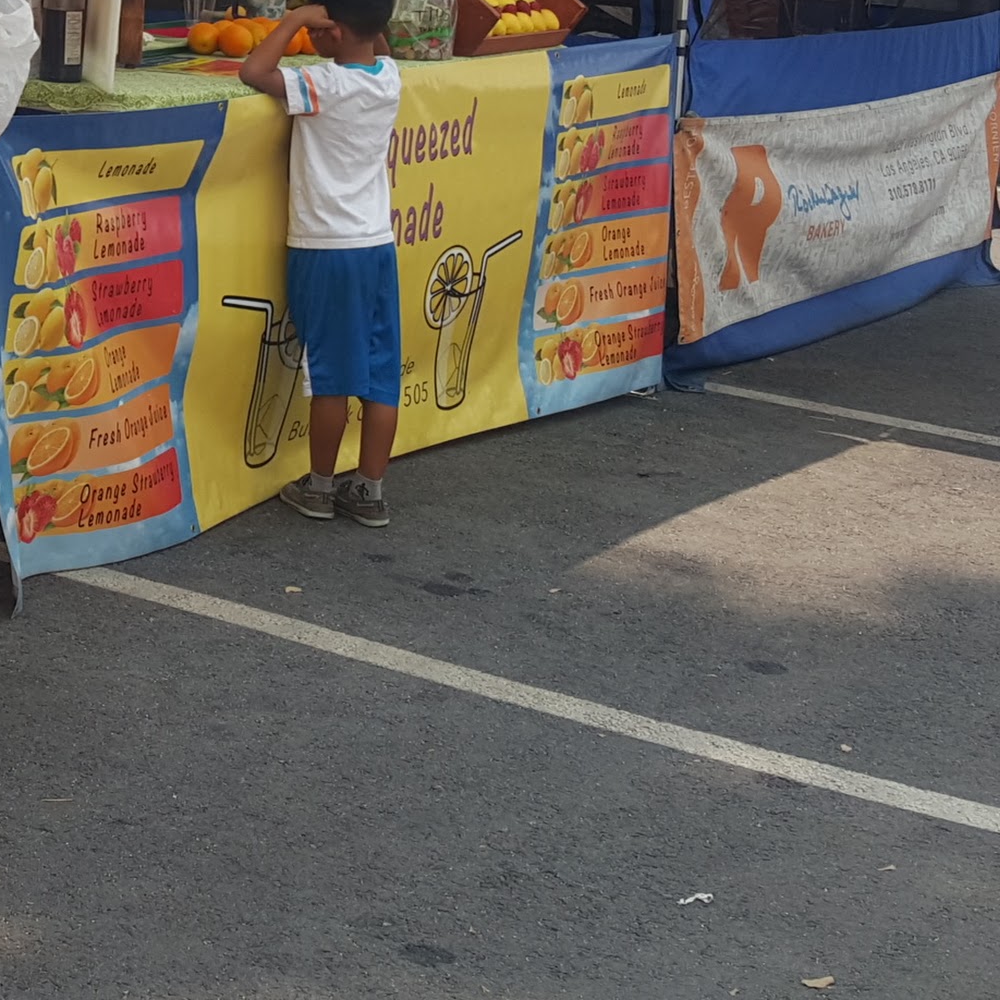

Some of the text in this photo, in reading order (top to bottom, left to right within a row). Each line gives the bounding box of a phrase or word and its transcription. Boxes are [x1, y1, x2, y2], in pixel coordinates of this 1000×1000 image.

[616, 80, 647, 99] Lemonade
[386, 96, 477, 189] queezed
[948, 123, 972, 139] Blvd.
[97, 157, 157, 179] Lemonade
[880, 162, 896, 178] Los
[932, 149, 946, 165] CA
[602, 171, 647, 192] Strawberry
[601, 194, 641, 211] Lemonade
[95, 210, 147, 235] Raspberry
[391, 183, 444, 247] nade
[601, 225, 631, 244] Orange
[806, 219, 846, 241] BAKERY
[93, 234, 145, 260] Lemonade
[603, 240, 645, 262] Lemonade
[91, 275, 153, 301] Strawberry
[589, 283, 614, 303] Fresh
[616, 281, 647, 299] Orange
[97, 302, 144, 328] Lmonade
[594, 329, 625, 348] Orange
[103, 344, 127, 368] Orange
[600, 344, 637, 367] Lemonade
[109, 363, 140, 393] Lemonade
[88, 402, 168, 450] Fresh Orange Juice
[80, 460, 175, 505] Orange Strawberry
[78, 498, 142, 529] Lemonade
